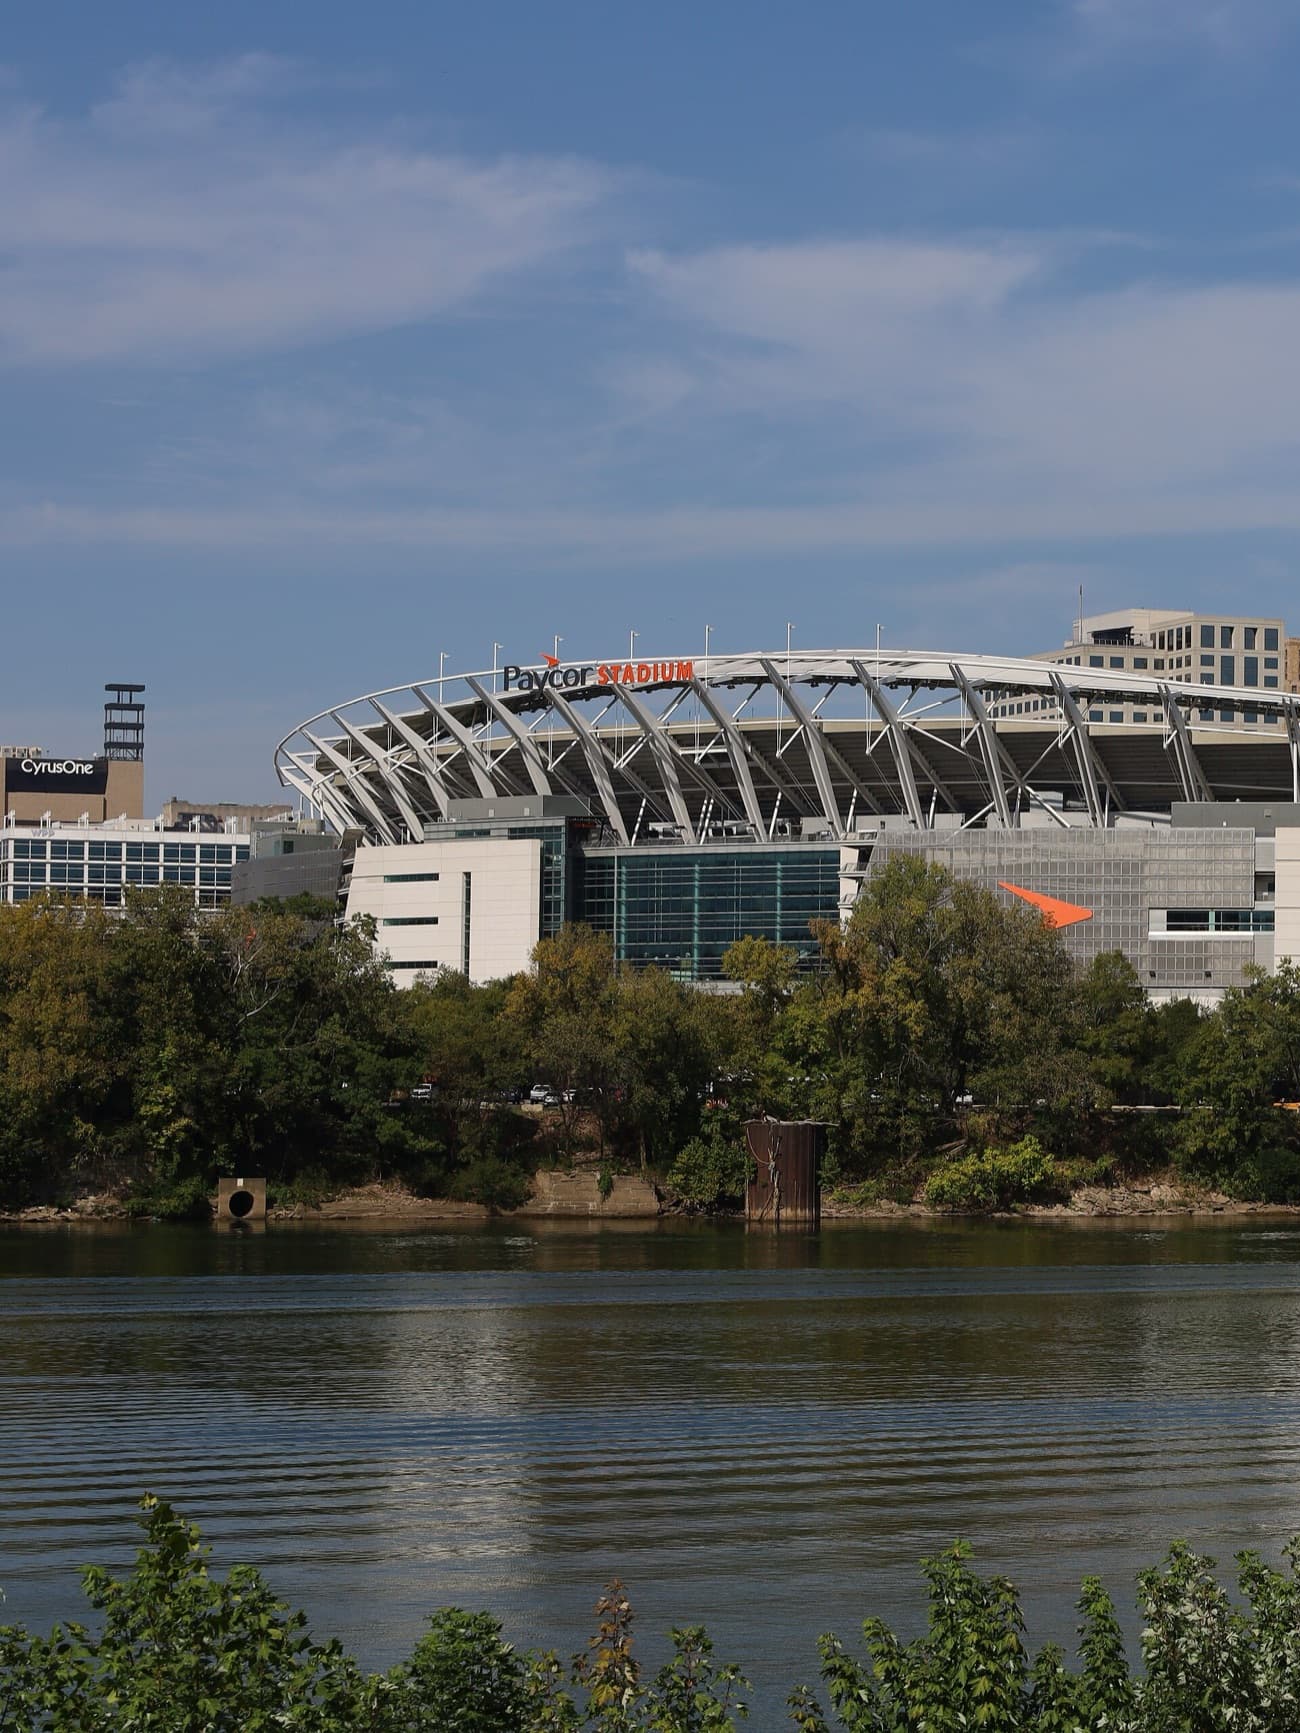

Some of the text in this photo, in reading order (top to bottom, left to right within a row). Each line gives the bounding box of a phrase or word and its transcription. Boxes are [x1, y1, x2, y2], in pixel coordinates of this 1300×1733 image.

[503, 660, 694, 699] Paycor STADIUM
[20, 759, 95, 776] CyrusOne
